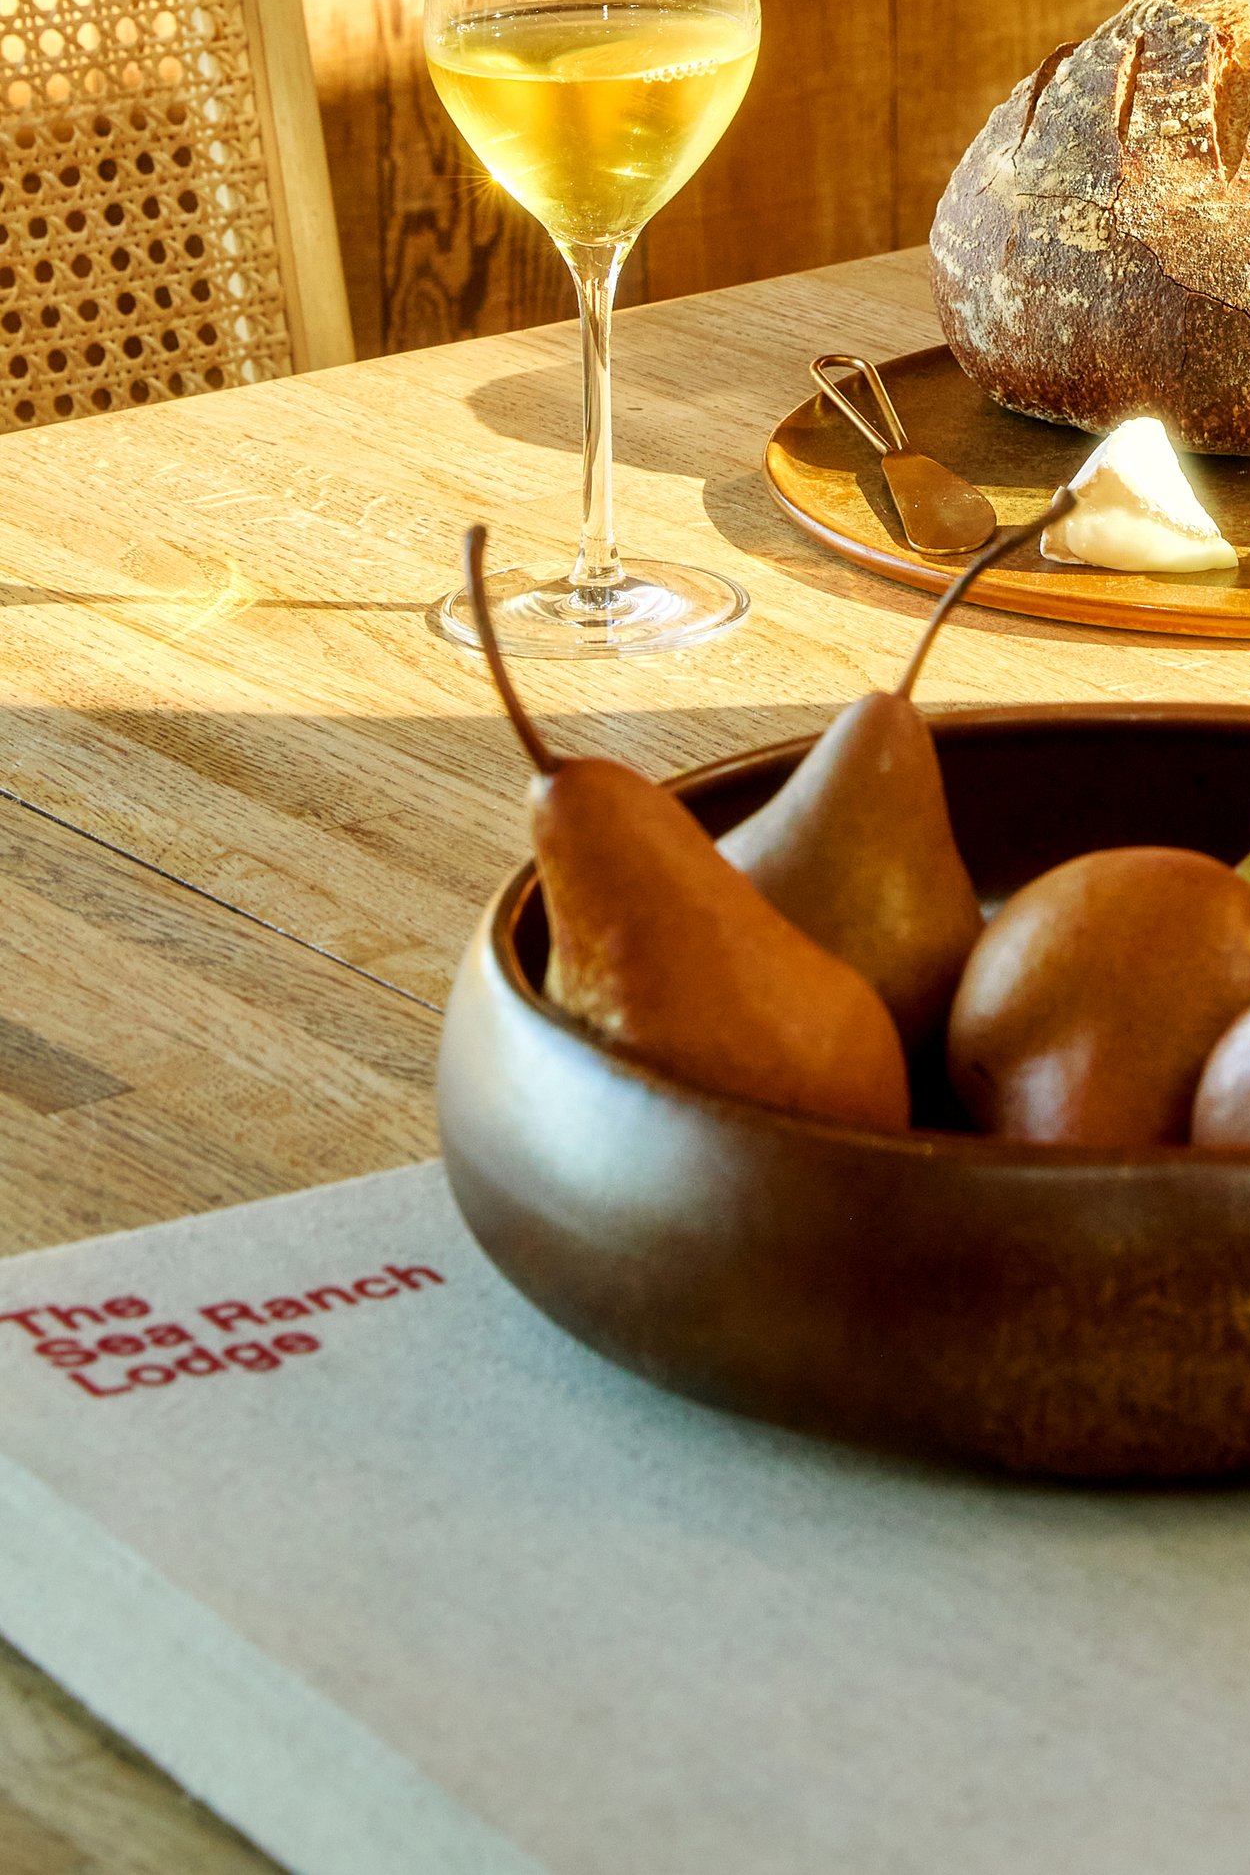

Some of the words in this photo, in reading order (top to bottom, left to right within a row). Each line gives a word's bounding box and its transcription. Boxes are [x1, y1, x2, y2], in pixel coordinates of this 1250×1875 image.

[0, 1295, 152, 1339] The
[34, 1323, 195, 1369] Sea
[198, 1263, 447, 1333] Ranch
[69, 1331, 322, 1398] Lodge
